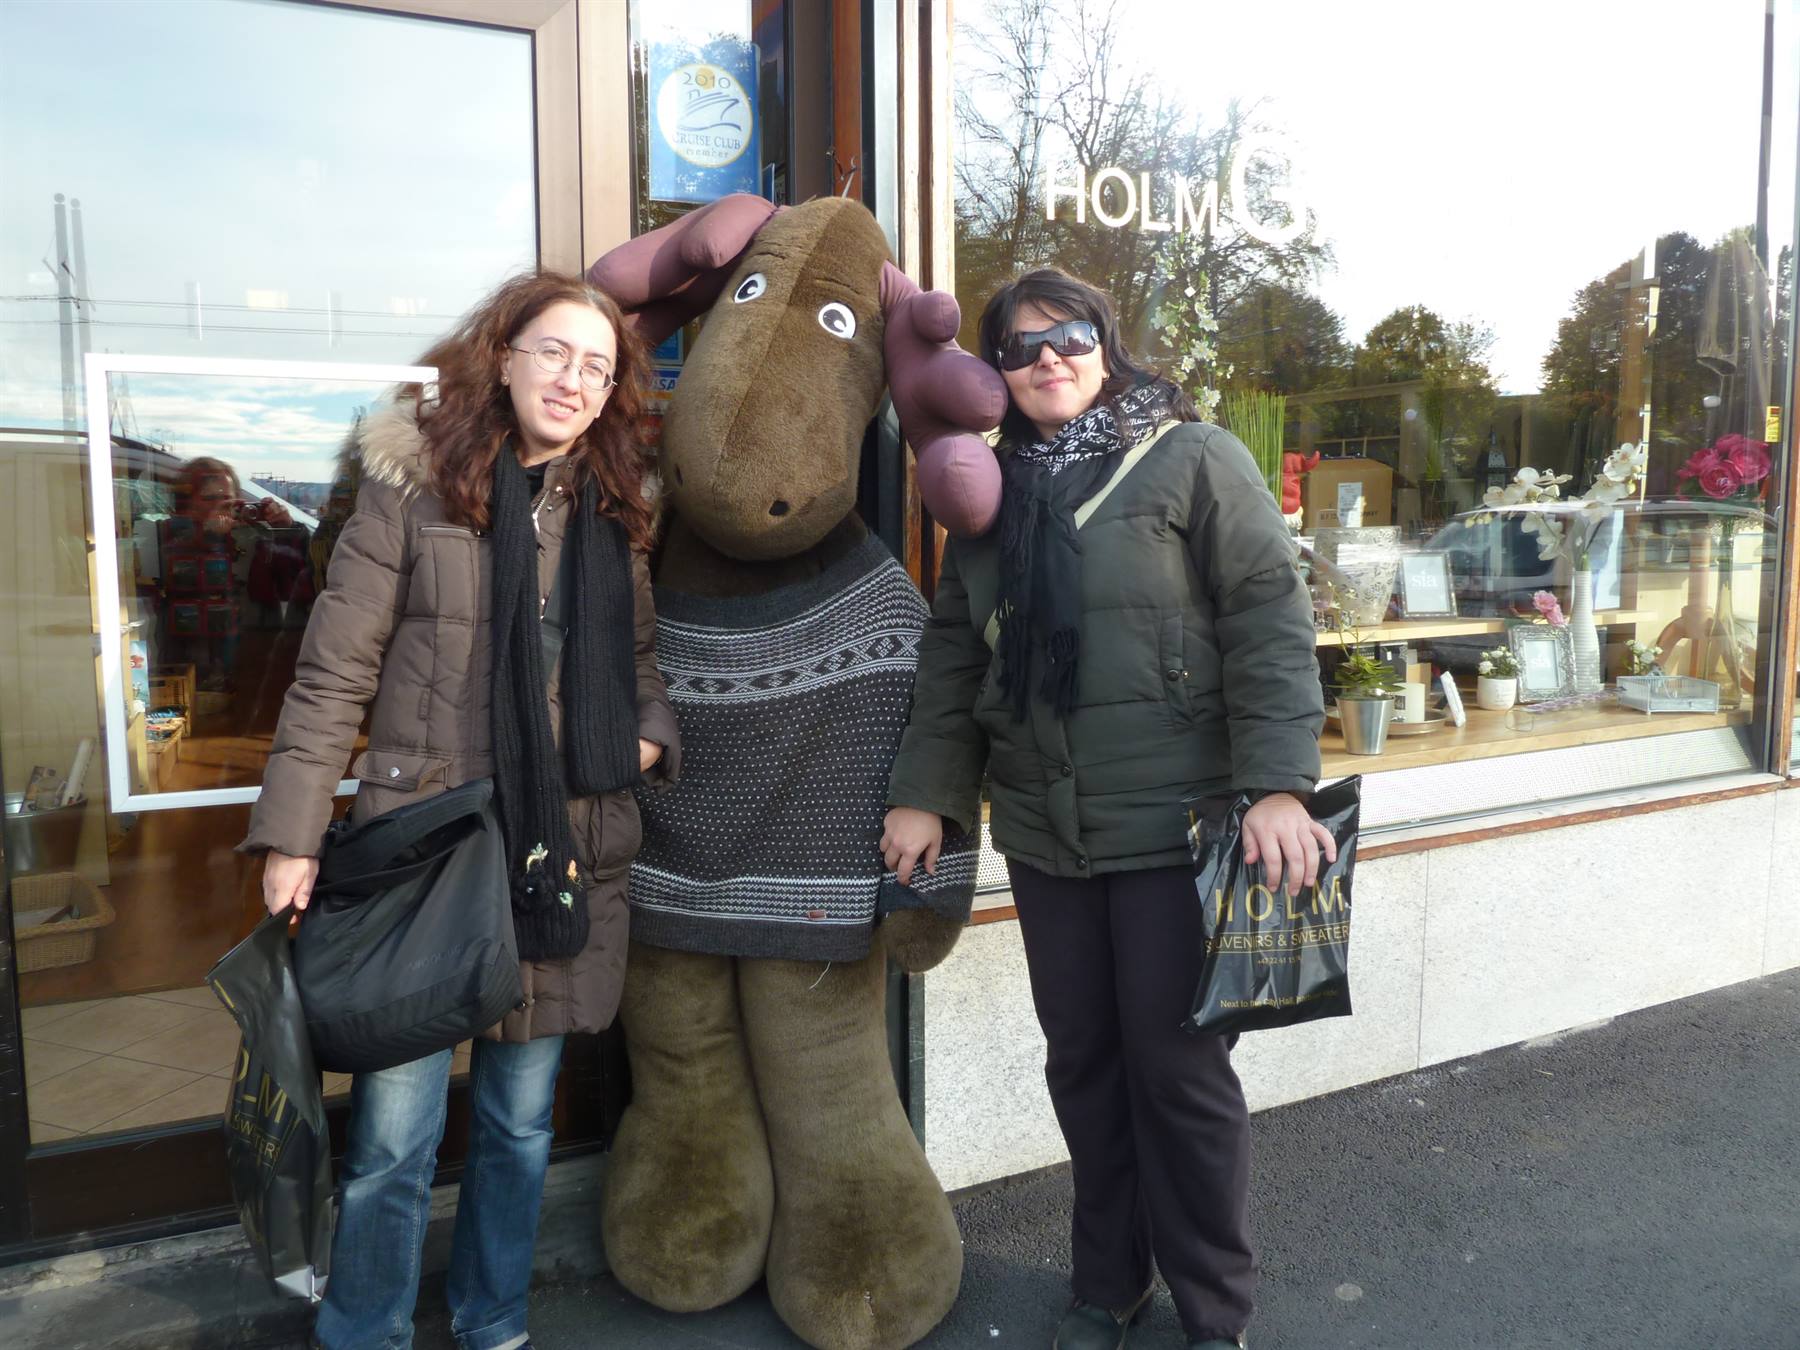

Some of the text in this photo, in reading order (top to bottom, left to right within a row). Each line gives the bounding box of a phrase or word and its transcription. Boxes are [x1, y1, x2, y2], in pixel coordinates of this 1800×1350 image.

[683, 71, 731, 90] 2010
[672, 131, 742, 150] CRUISE CLUB
[1411, 570, 1439, 588] sia
[1215, 875, 1345, 926] HOLM
[1277, 934, 1288, 947] &
[1291, 925, 1350, 946] SWEATER
[1220, 999, 1239, 1008] Next
[1240, 999, 1249, 1008] to
